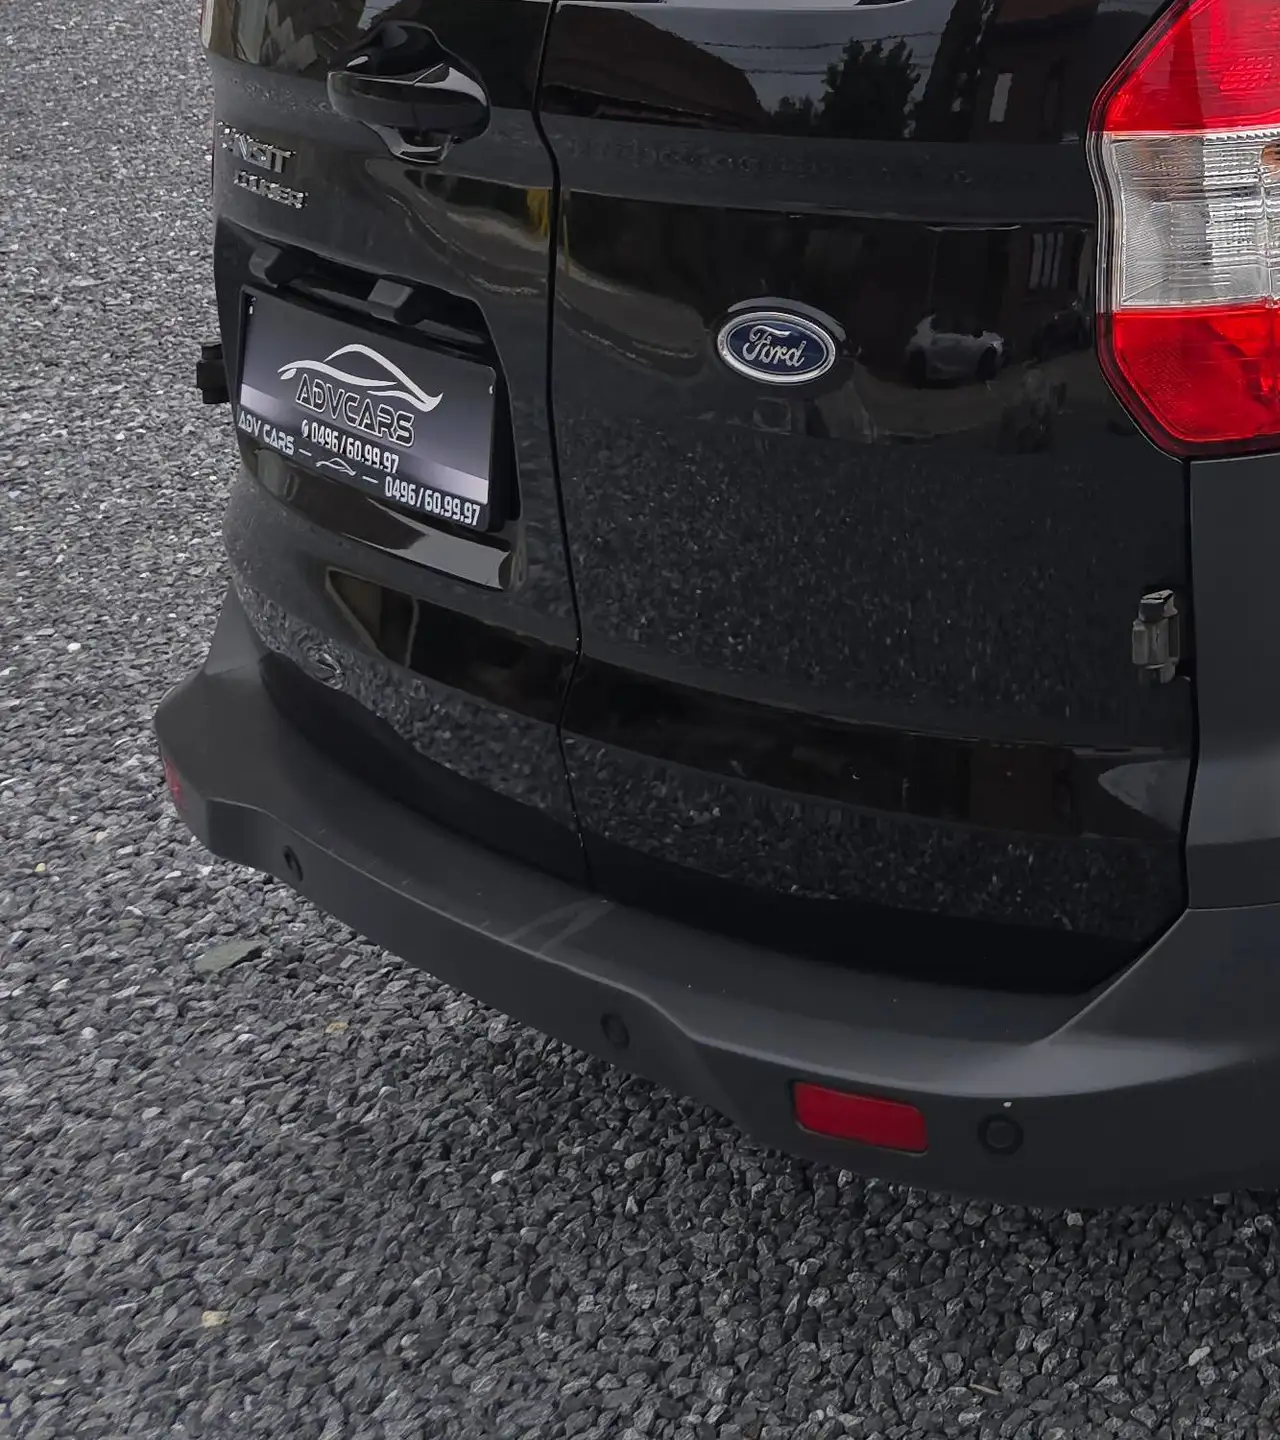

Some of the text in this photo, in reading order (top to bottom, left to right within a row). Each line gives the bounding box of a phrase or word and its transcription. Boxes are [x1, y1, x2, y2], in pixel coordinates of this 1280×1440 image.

[742, 324, 807, 367] Ford
[238, 410, 295, 456] ADV CARS
[295, 373, 416, 448] ADVCARS
[311, 422, 399, 474] 0496/60.99.97
[384, 476, 481, 527] 0496/60.99.97
